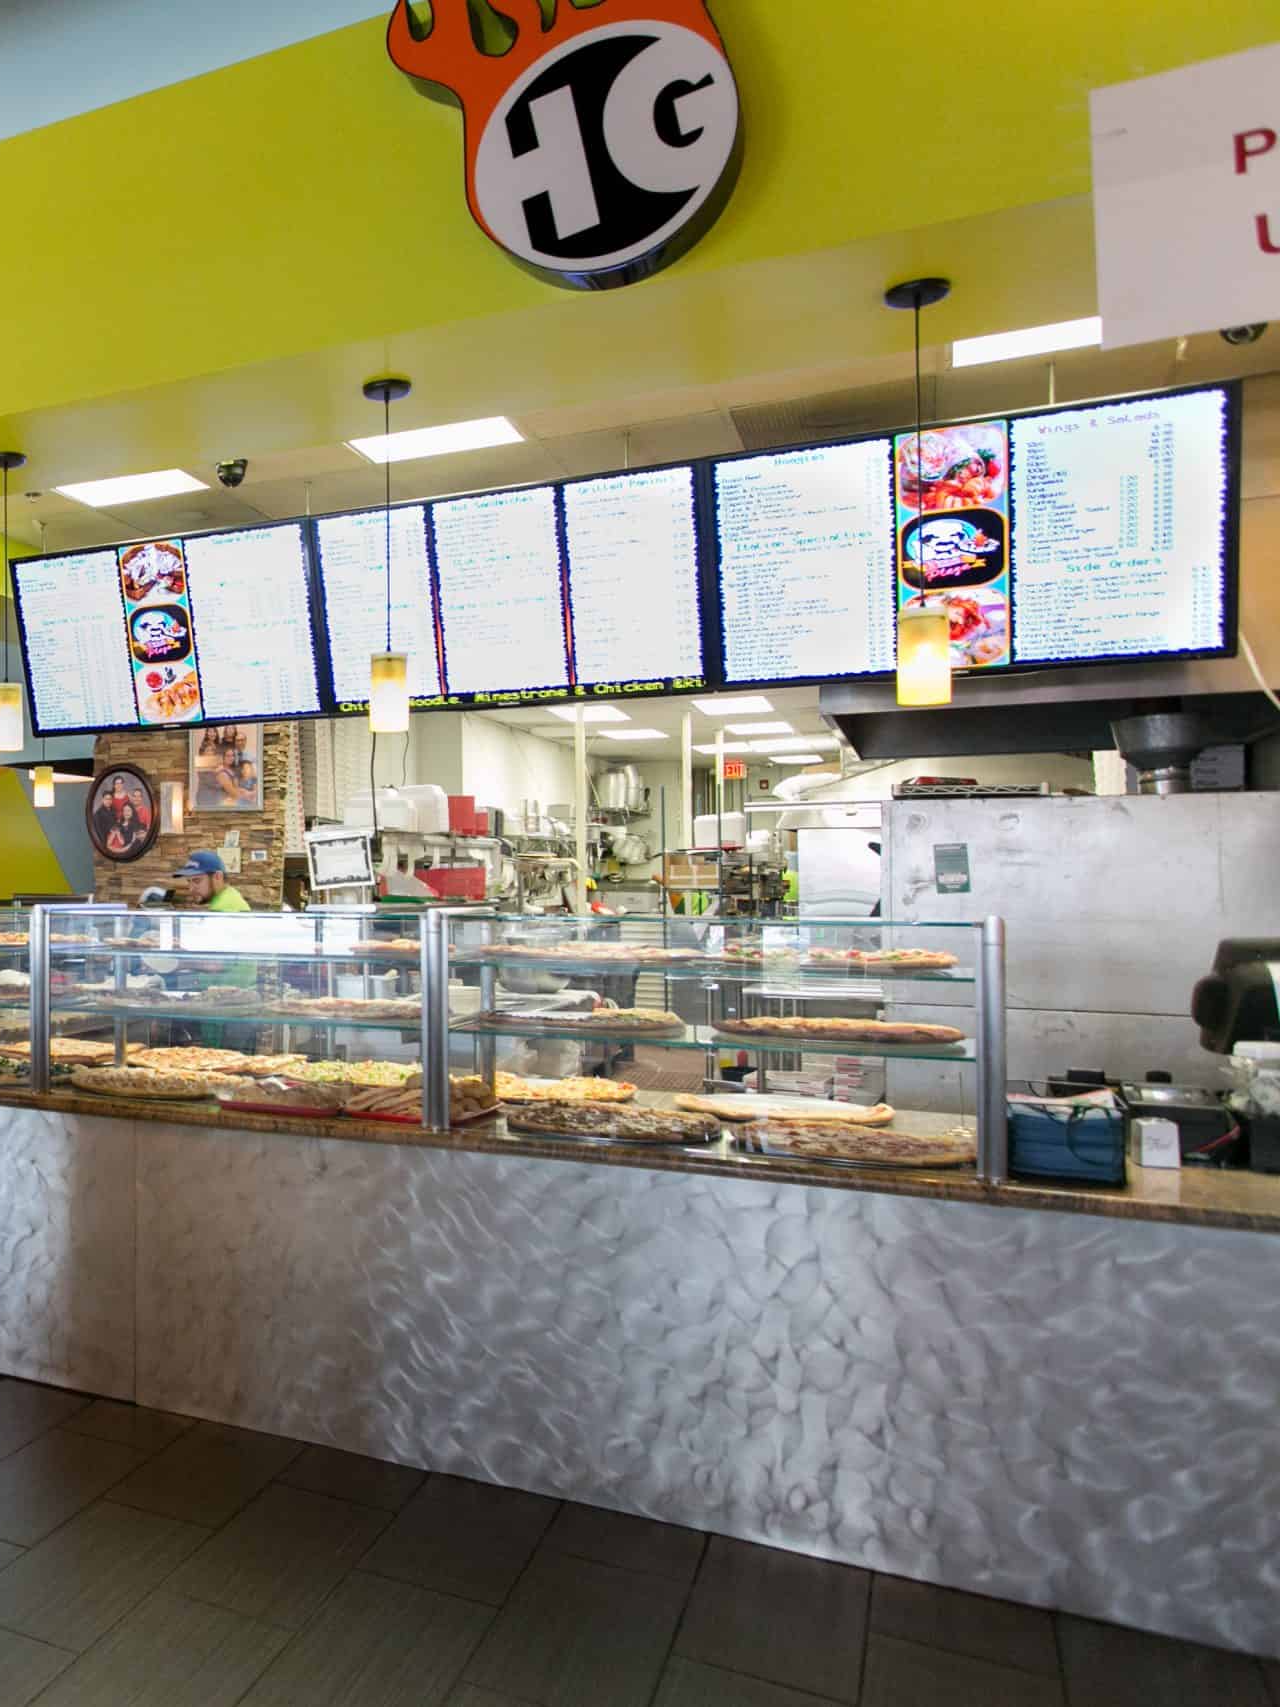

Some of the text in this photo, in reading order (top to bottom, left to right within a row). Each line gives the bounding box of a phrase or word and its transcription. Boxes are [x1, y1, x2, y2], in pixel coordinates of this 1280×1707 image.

[480, 32, 738, 262] HG
[1066, 562, 1102, 573] Side
[1108, 557, 1162, 570] Orders
